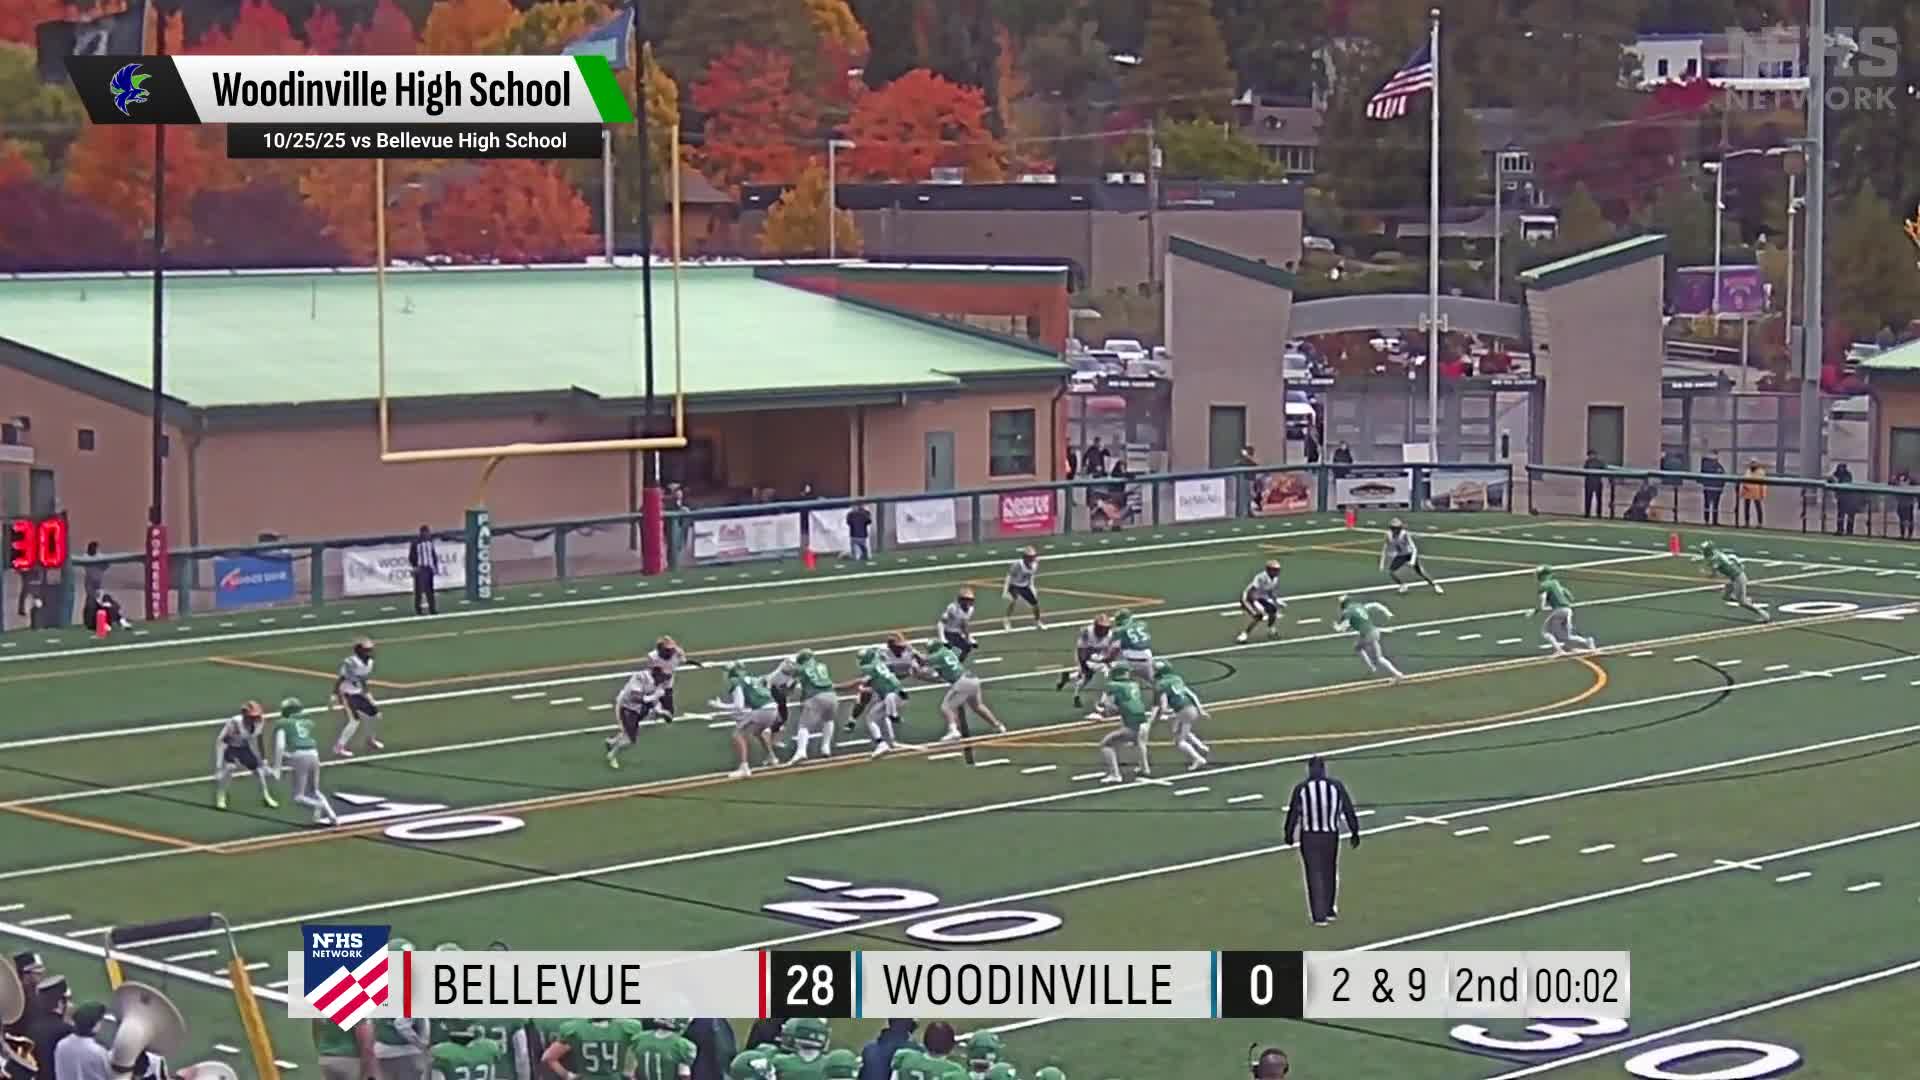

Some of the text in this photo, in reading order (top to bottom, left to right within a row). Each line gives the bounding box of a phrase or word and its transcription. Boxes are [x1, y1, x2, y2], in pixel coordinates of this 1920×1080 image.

[11, 519, 67, 570] 30
[477, 513, 491, 599] FALCONS
[762, 887, 1062, 942] 20
[582, 1042, 619, 1073] 54
